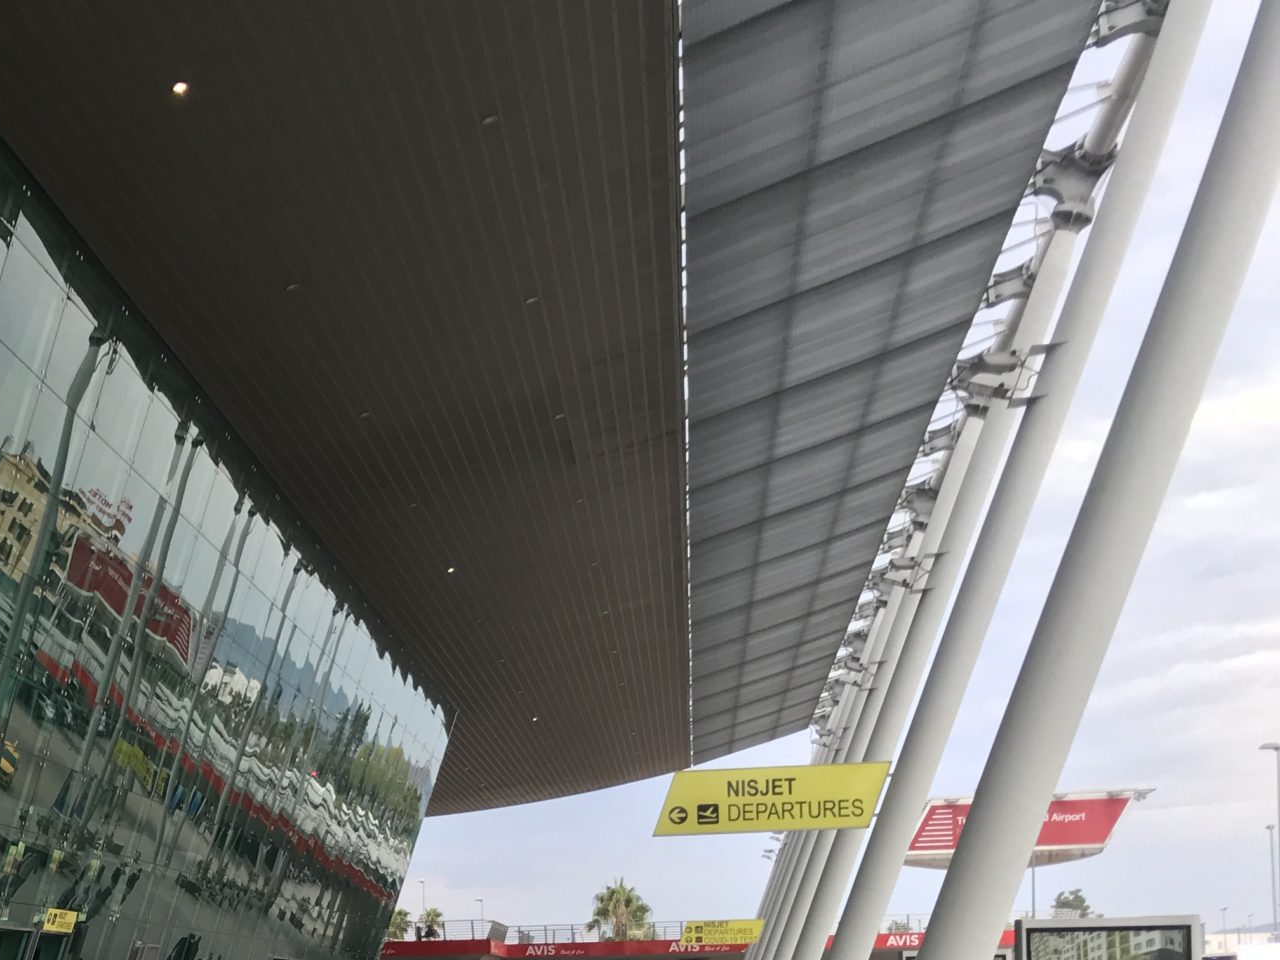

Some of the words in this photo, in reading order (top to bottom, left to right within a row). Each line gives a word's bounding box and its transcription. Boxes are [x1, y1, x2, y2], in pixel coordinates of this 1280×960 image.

[727, 778, 796, 798] NISJET
[728, 799, 864, 822] DEPARTURES
[1051, 812, 1085, 823] Airport
[704, 921, 729, 929] NISJET
[704, 928, 754, 936] DEPARTURES
[886, 934, 919, 947] AVIS
[525, 945, 556, 956] AVIS
[669, 942, 700, 952] AVIS
